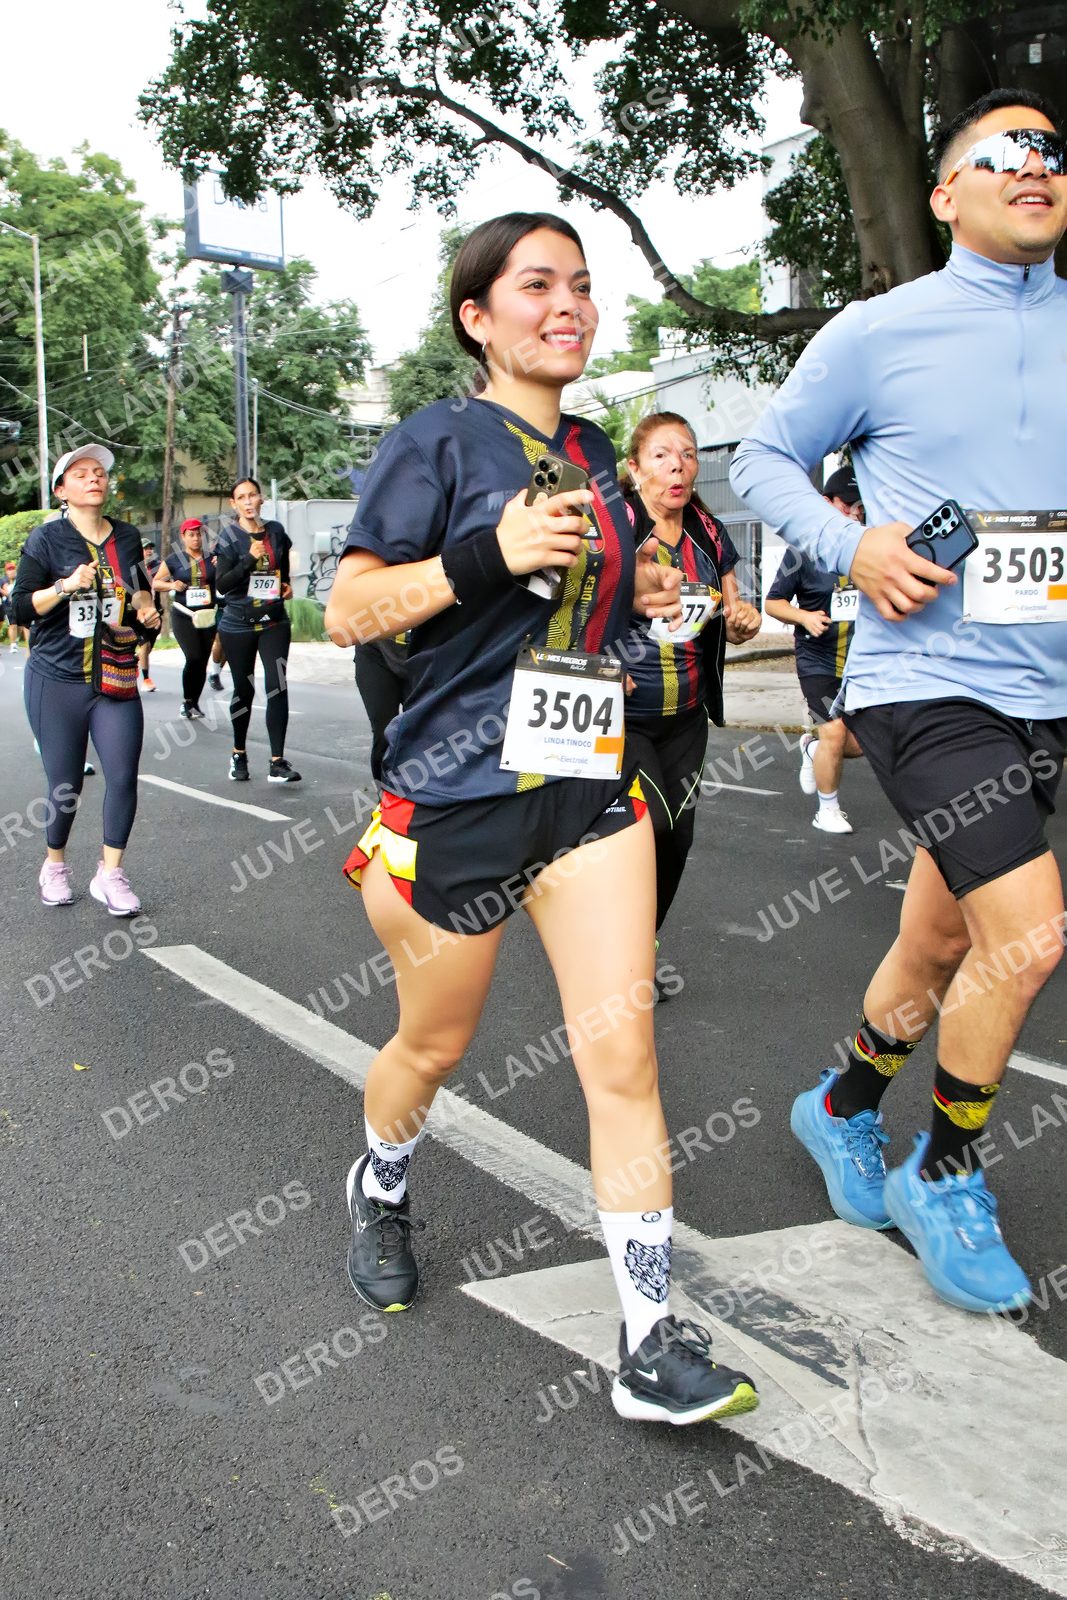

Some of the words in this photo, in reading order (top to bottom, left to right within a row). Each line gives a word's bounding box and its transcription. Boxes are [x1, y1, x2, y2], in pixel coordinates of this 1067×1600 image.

[982, 546, 1065, 583] 3503
[254, 579, 275, 589] 5767
[77, 604, 112, 622] 335
[527, 688, 614, 735] 3504
[544, 737, 566, 746] LINDA
[566, 738, 592, 748] TINOCO
